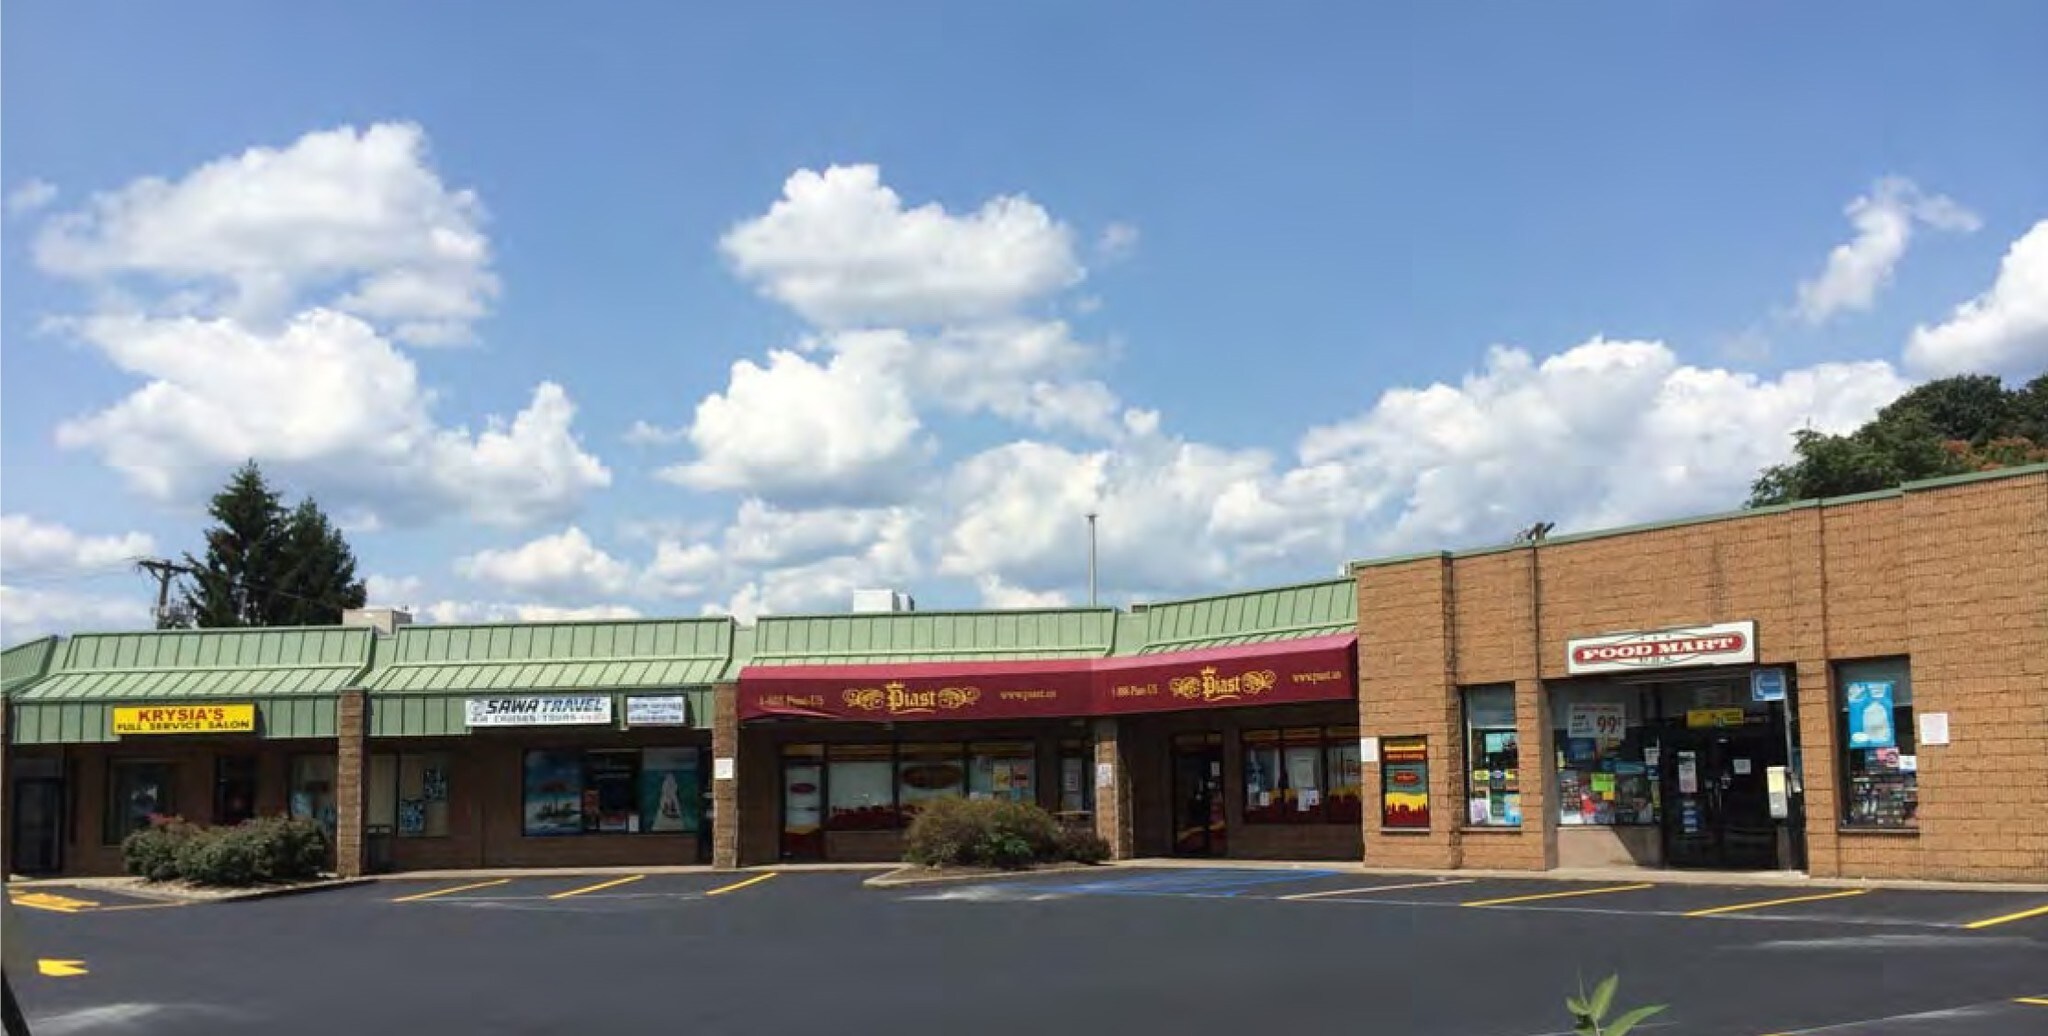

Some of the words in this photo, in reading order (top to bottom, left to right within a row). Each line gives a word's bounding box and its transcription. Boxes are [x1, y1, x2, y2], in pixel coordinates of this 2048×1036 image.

[1582, 644, 1652, 660] FOOD
[1658, 638, 1734, 654] MART
[1203, 673, 1240, 697] Piast
[485, 700, 539, 714] SAWA
[542, 698, 603, 713] TRAVEL
[886, 686, 936, 710] Piast
[138, 708, 224, 722] KRYSIA'S
[117, 723, 143, 731] FULL
[149, 721, 201, 731] SERVICE
[208, 720, 249, 729] SALON
